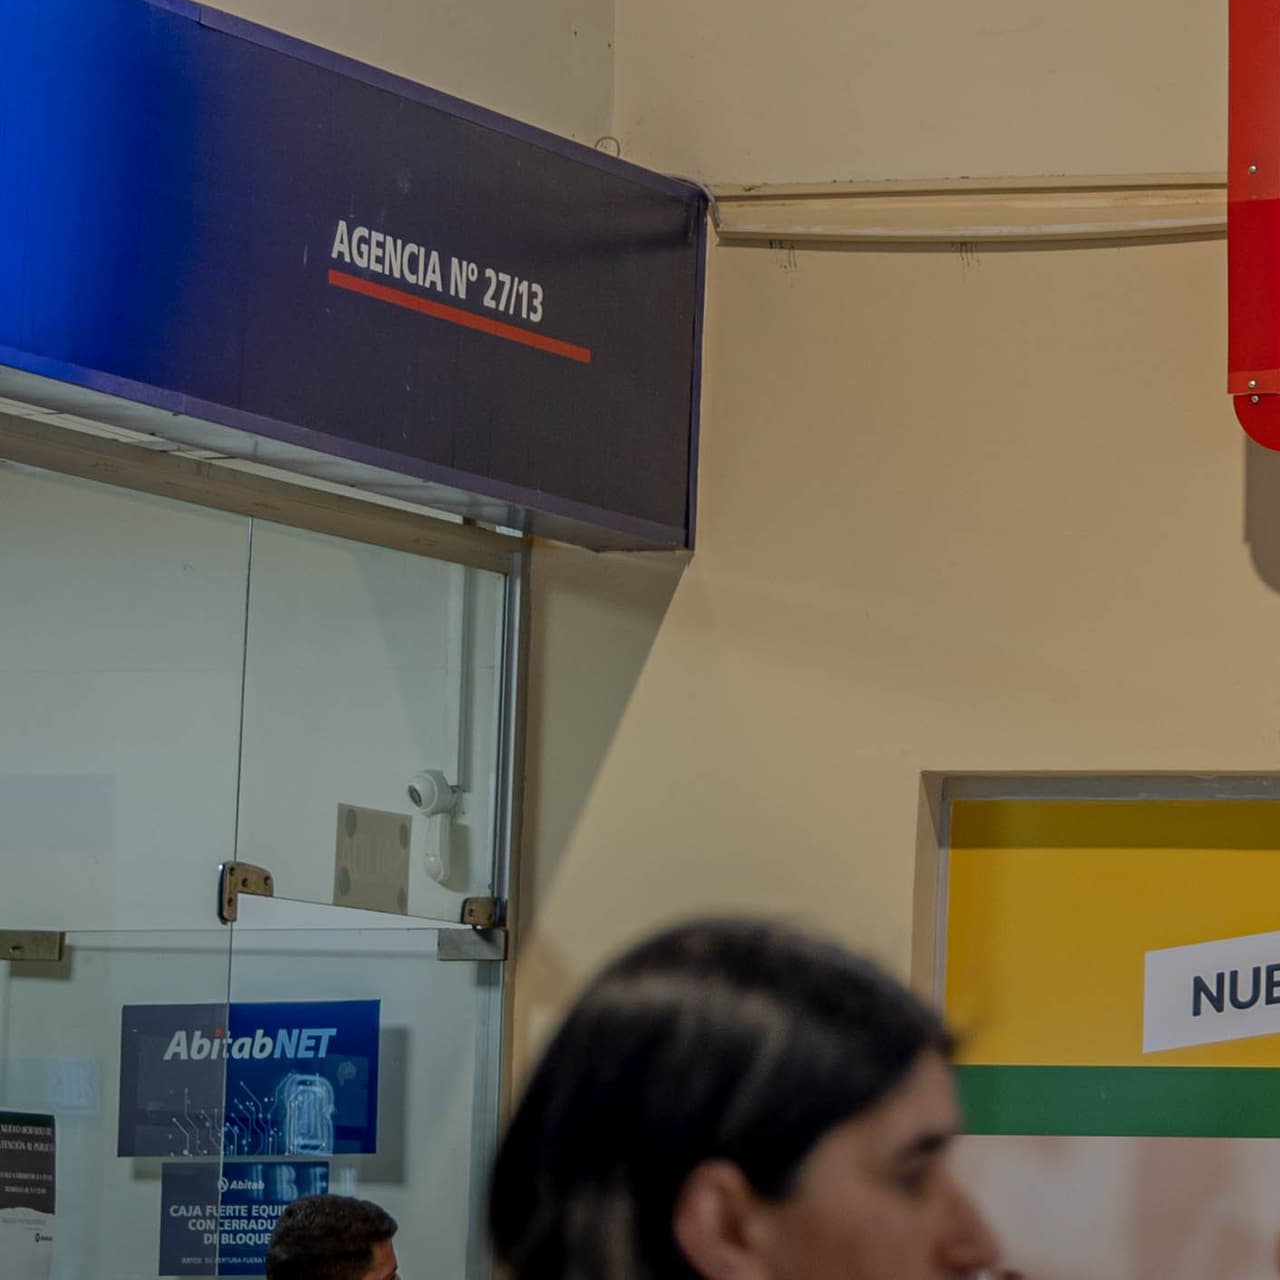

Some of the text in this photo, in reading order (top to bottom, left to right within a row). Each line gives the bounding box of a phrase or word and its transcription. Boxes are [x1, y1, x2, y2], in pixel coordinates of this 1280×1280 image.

[331, 220, 443, 292] AGENCIA
[483, 268, 544, 323] 27/13
[163, 1028, 337, 1061] AbitabNET
[230, 1179, 265, 1190] Abitab
[169, 1205, 202, 1217] CAJA
[205, 1205, 248, 1217] FUERTE
[188, 1219, 276, 1230] CON CERRADU
[221, 1233, 273, 1246] BLOQUE
